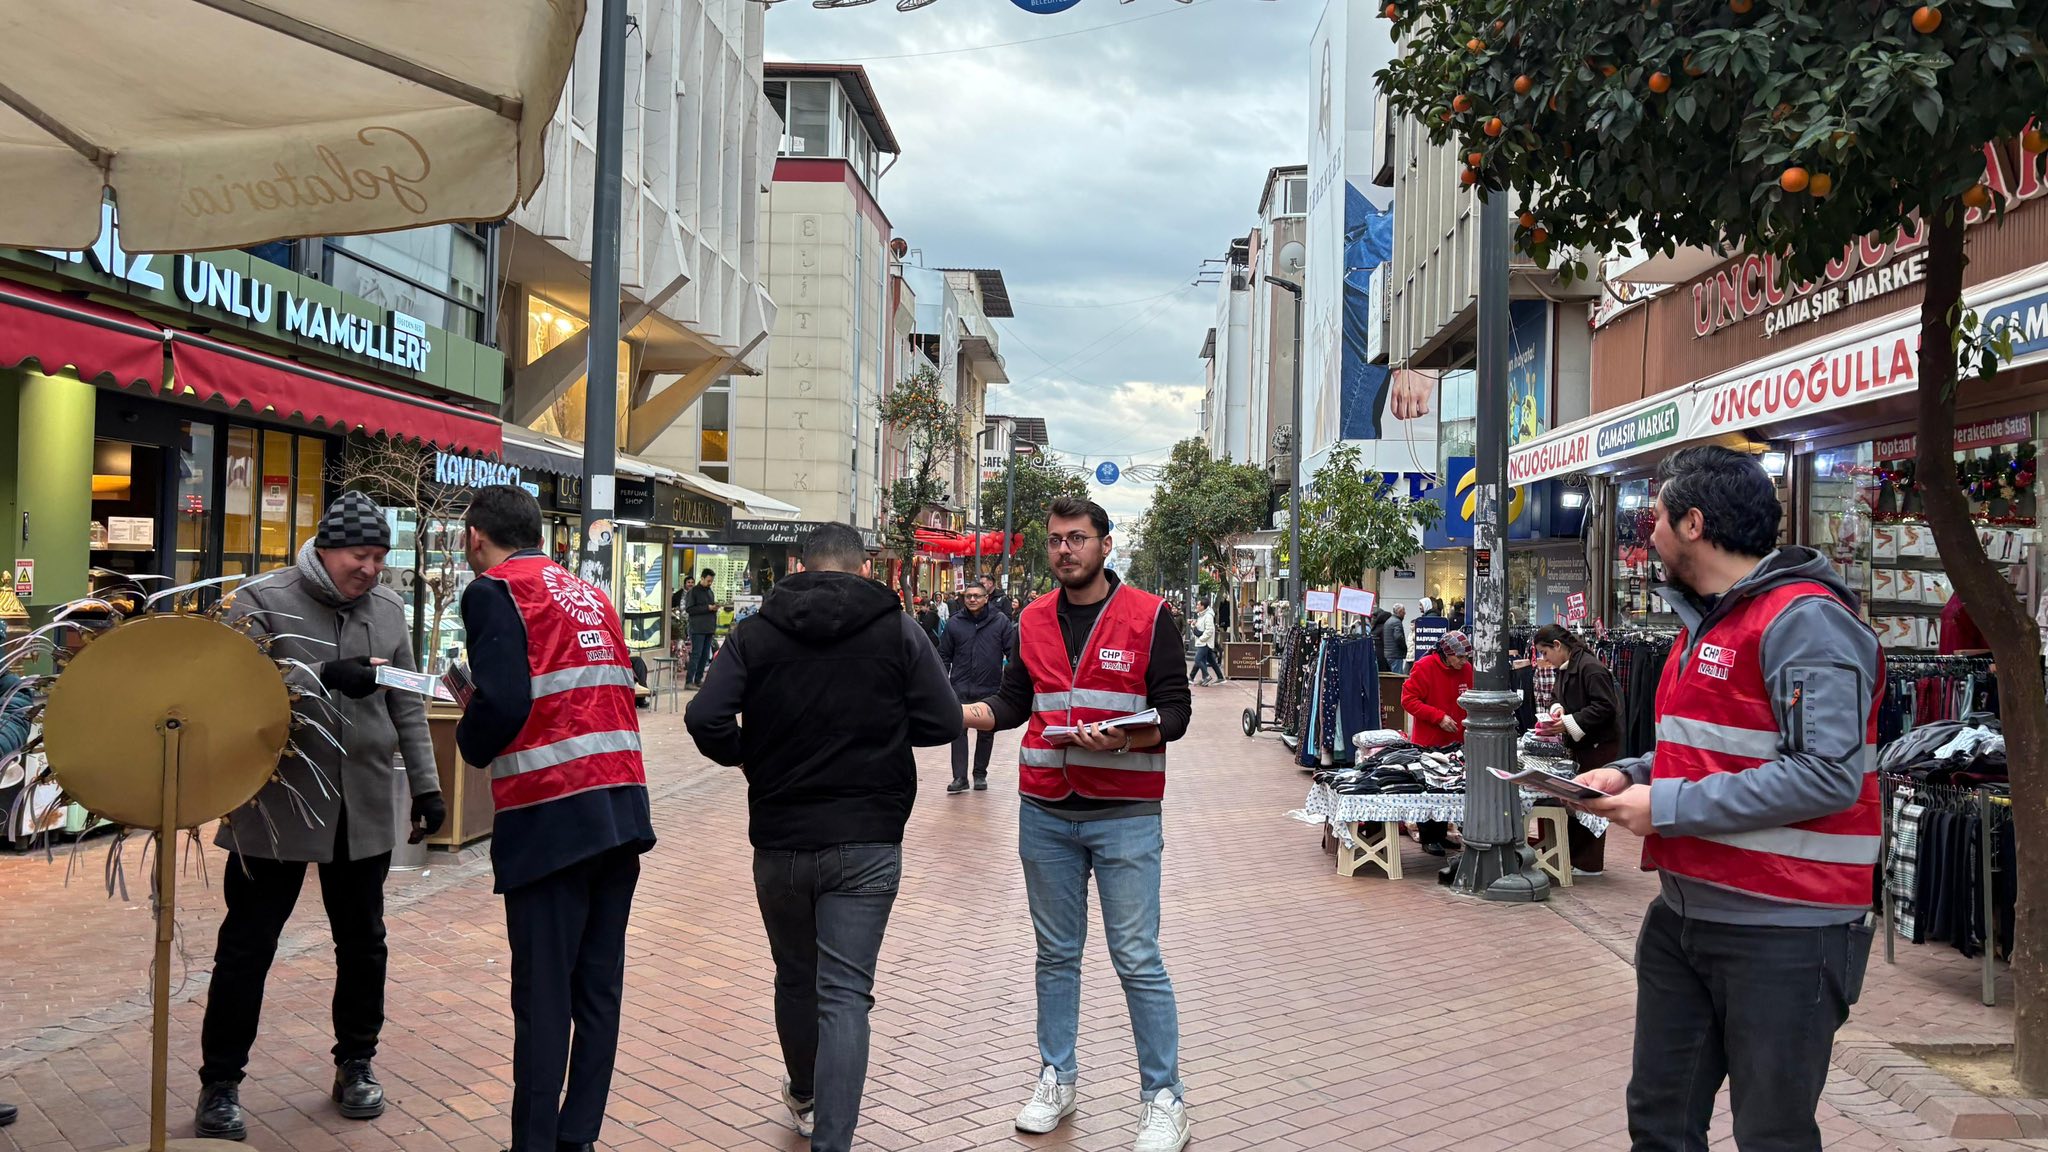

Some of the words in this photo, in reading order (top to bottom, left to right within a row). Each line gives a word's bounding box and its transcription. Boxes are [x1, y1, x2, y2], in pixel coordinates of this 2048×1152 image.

[1764, 290, 1840, 338] ÇAMAŞIR
[1848, 252, 1929, 305] MARKE
[1710, 336, 1921, 425] UNCUOĞULLA
[1599, 428, 1637, 455] ÇAMAŞIR
[1637, 410, 1676, 439] MARKET
[1876, 435, 1910, 457] Toptan
[1509, 434, 1590, 481] NCUOĞULLARI
[620, 489, 648, 497] PERFUME
[736, 521, 778, 532] Teknoloji
[767, 533, 798, 543] Adresi
[580, 633, 600, 645] CHP
[1102, 650, 1120, 659] CHP
[1703, 646, 1719, 659] CHP
